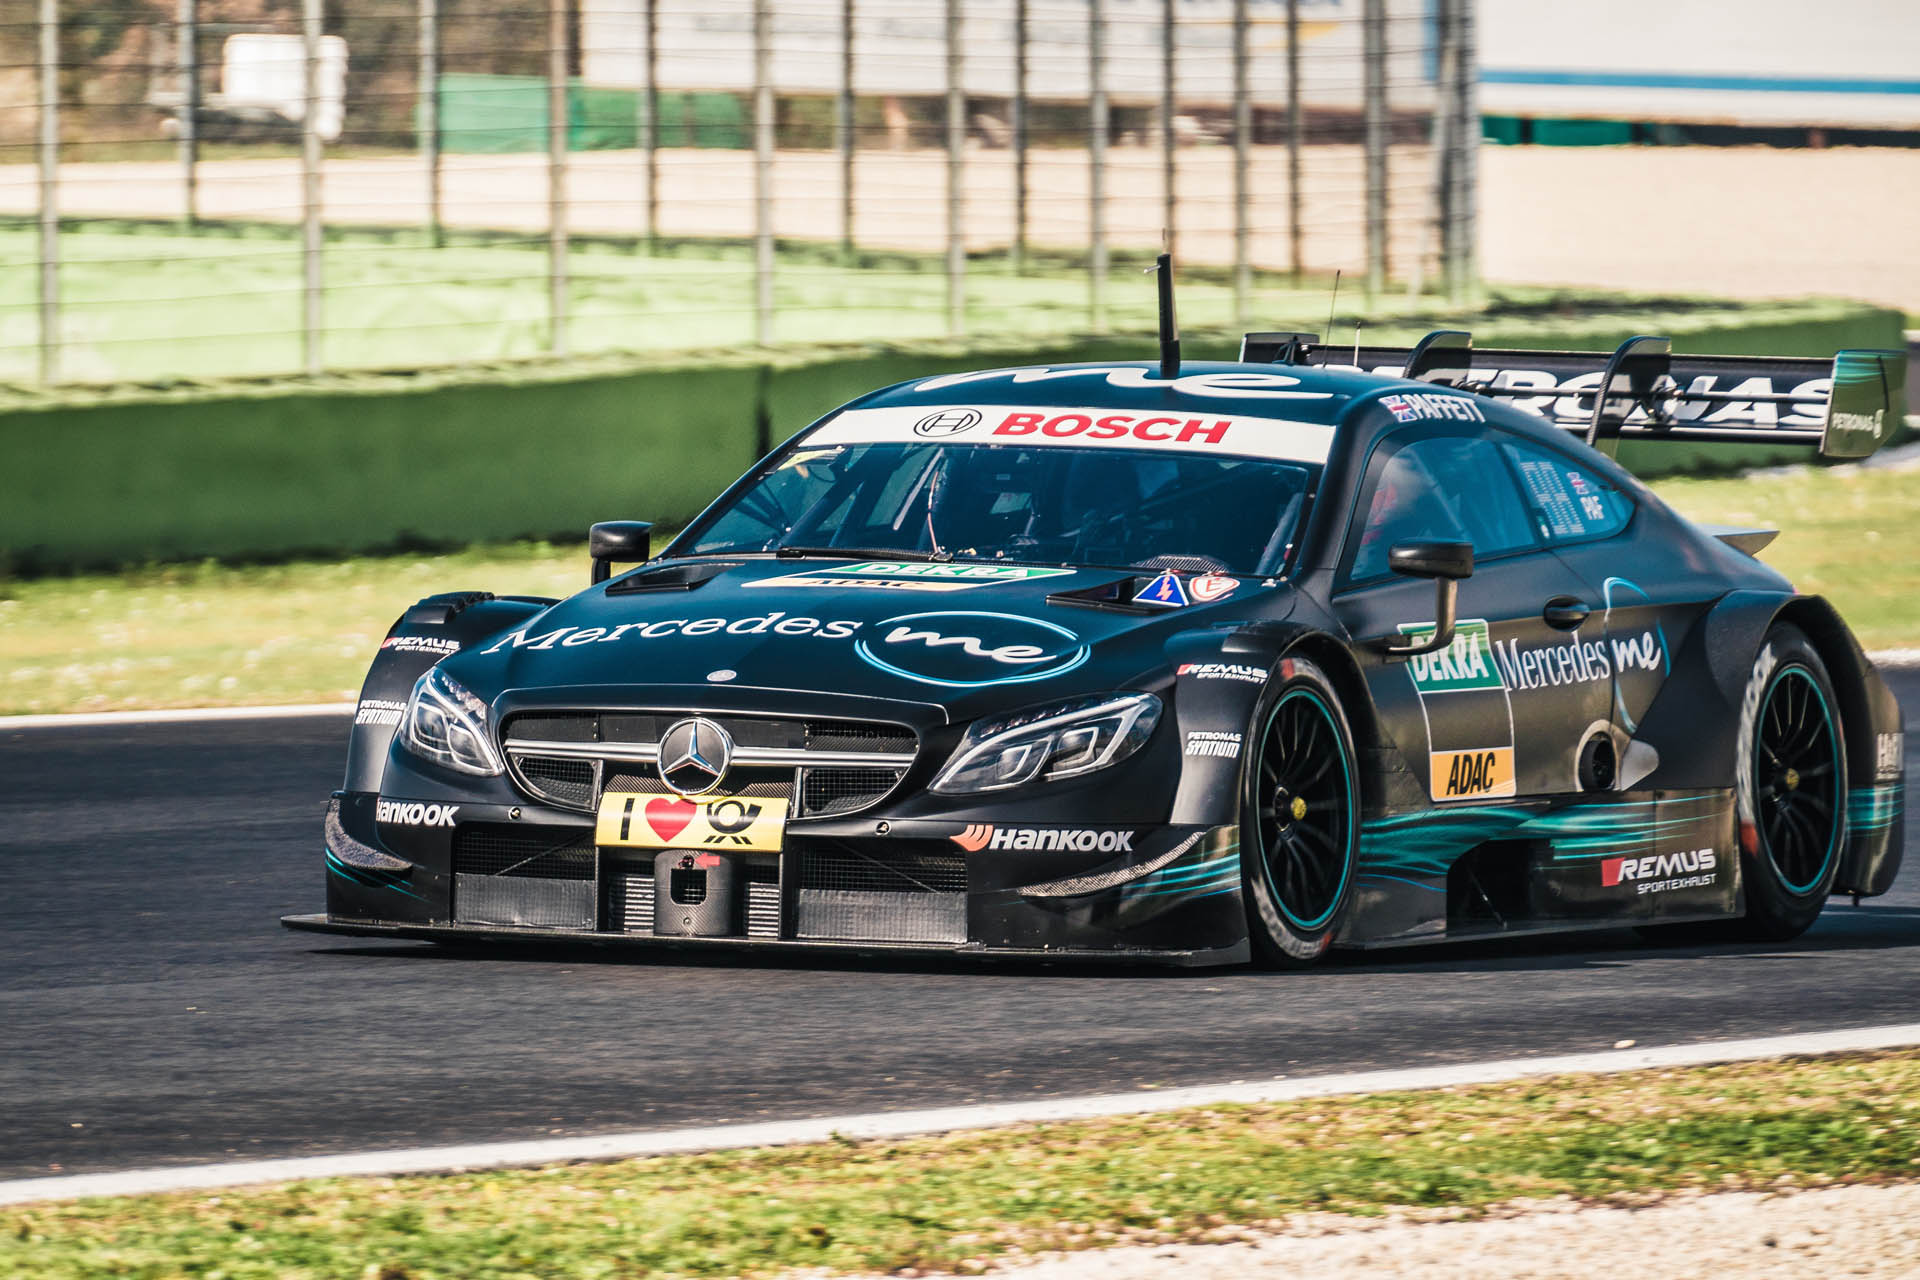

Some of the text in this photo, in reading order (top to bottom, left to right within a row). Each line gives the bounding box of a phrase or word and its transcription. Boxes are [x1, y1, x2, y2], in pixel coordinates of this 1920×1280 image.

[1402, 393, 1486, 423] PAFFETT
[992, 412, 1232, 444] BOSCH
[856, 563, 1030, 577] DEKRA
[387, 636, 460, 650] REMUS
[480, 612, 1057, 664] Mercedes me
[1185, 663, 1268, 679] REMUS
[1496, 629, 1662, 692] Mercedes me
[359, 700, 407, 711] PETRONAS
[1187, 731, 1242, 742] PETRONAS
[1446, 751, 1497, 796] ADAC
[620, 797, 636, 841] I
[1616, 847, 1717, 882] REMUS
[1637, 873, 1717, 894] SPORTEXHAUST
